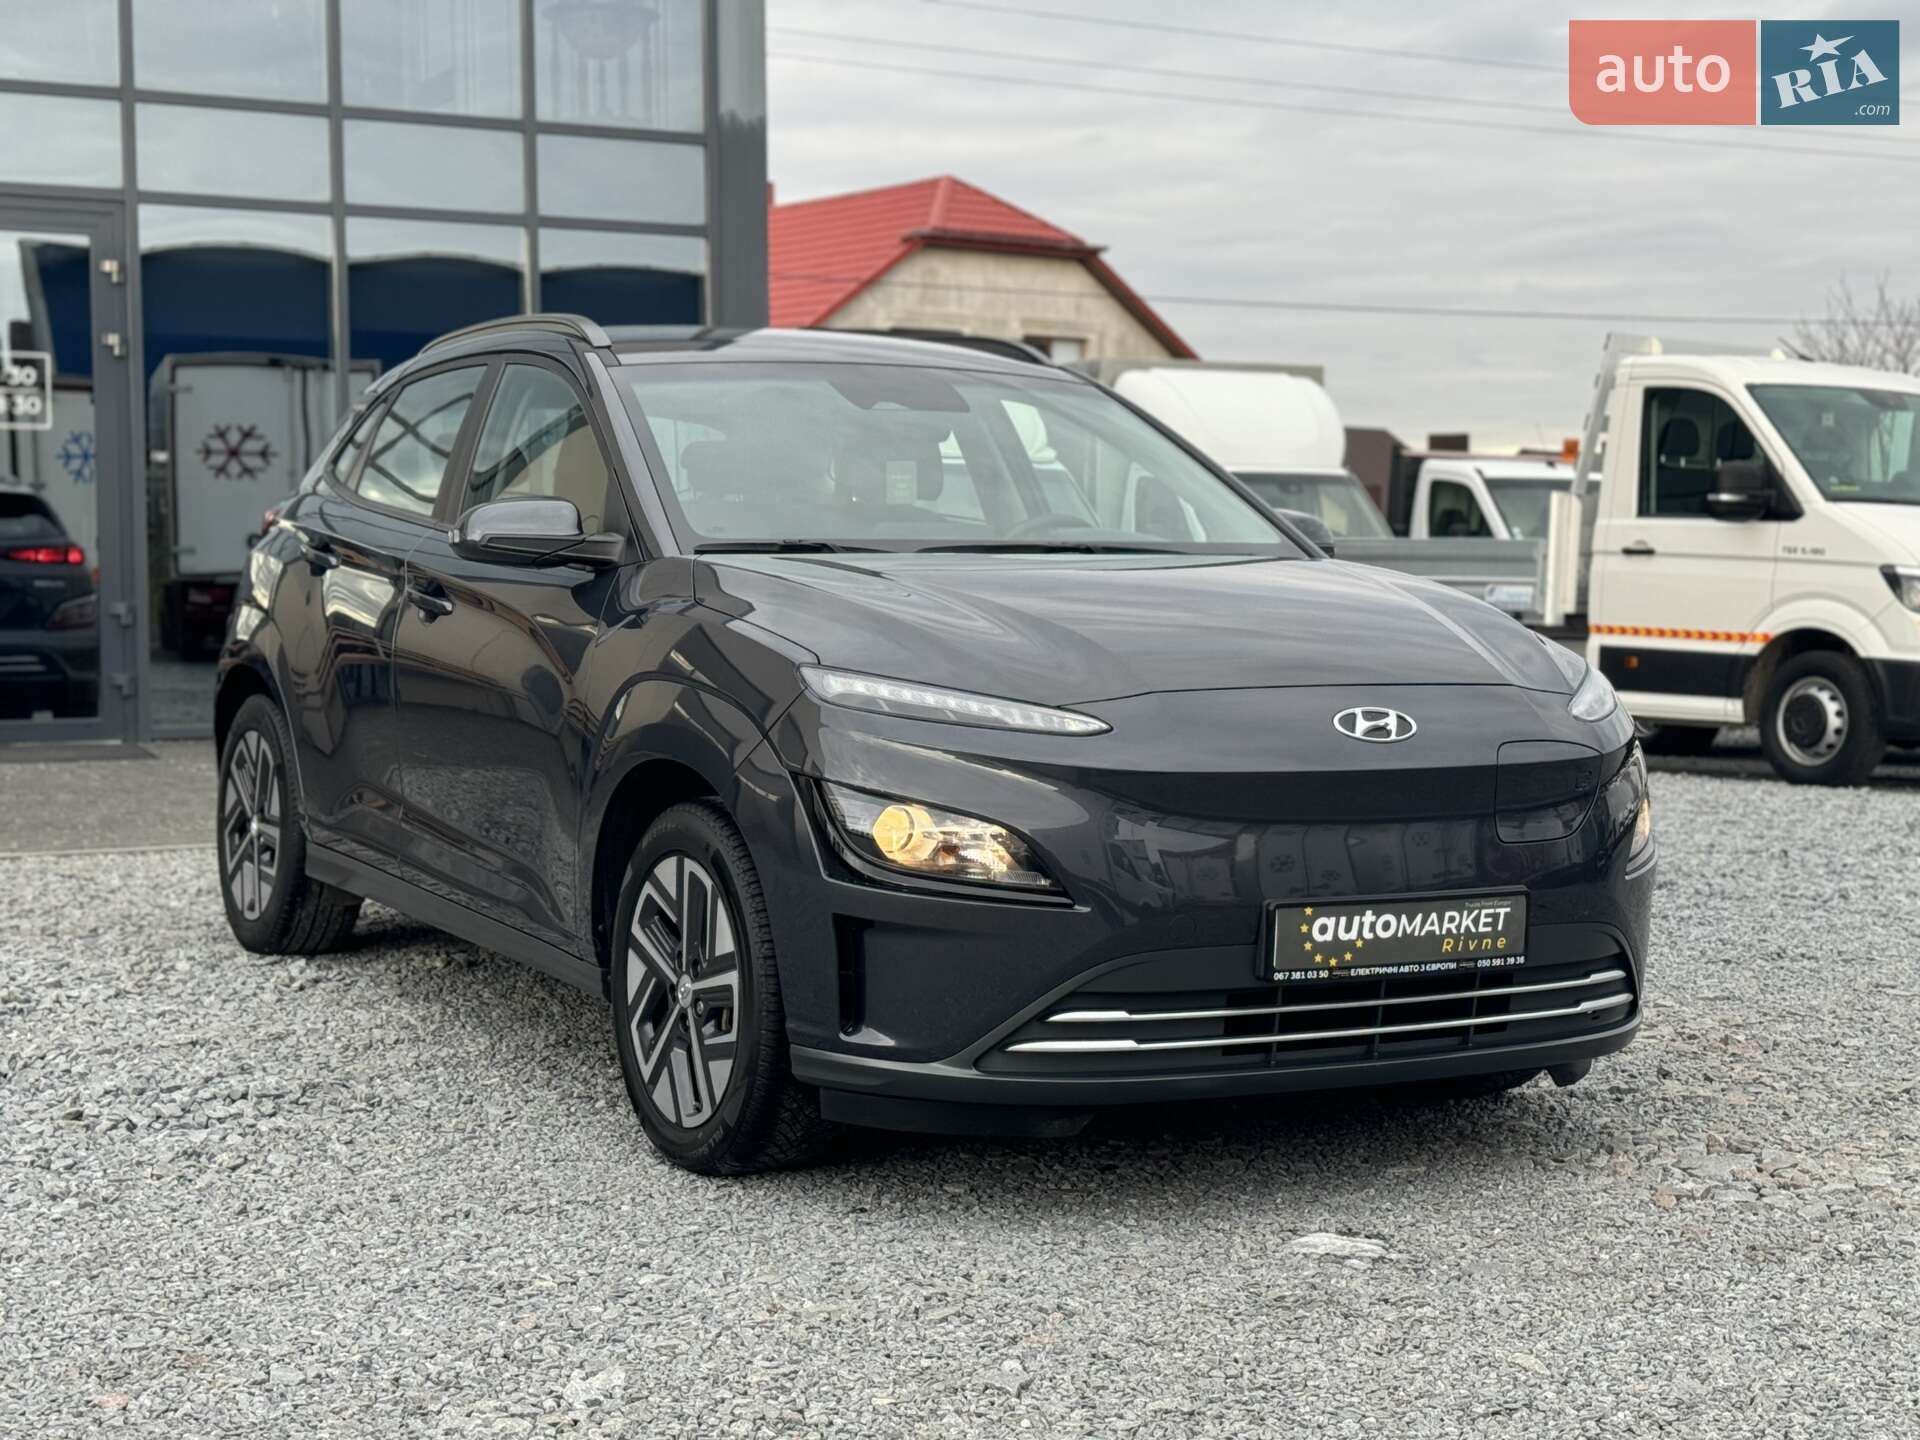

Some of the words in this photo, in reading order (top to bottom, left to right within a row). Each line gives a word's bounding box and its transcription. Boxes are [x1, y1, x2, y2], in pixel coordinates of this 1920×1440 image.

[1442, 936, 1507, 953] Rivne
[1273, 971, 1289, 981] 067
[1306, 970, 1318, 979] 03
[1398, 963, 1420, 973] АВТО
